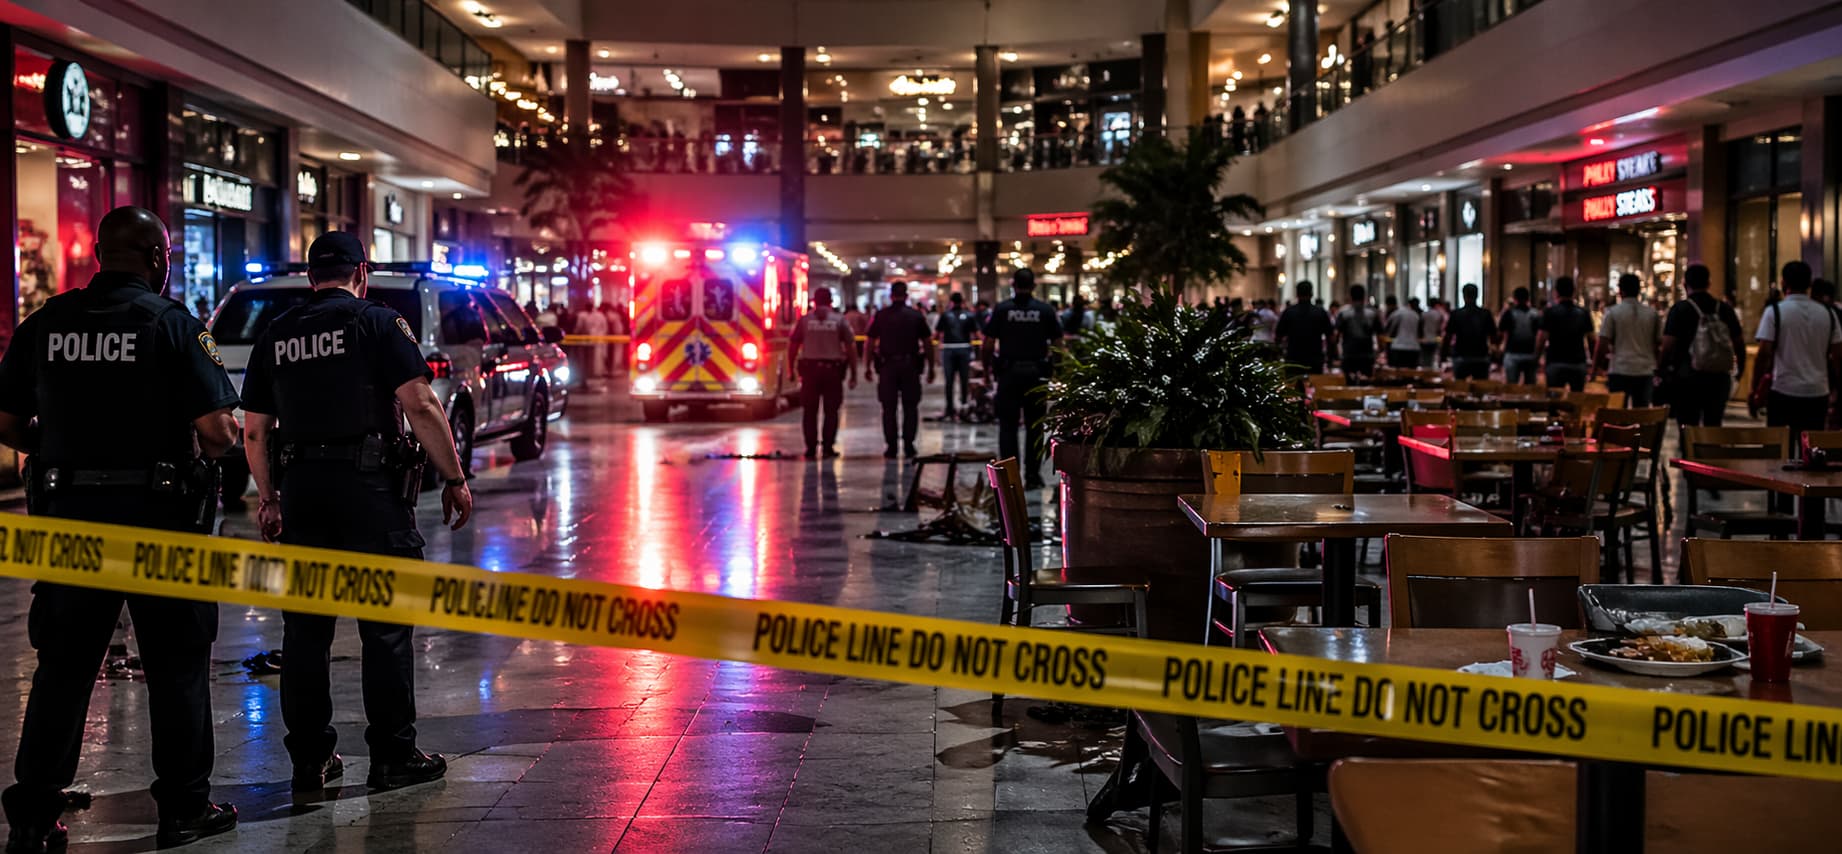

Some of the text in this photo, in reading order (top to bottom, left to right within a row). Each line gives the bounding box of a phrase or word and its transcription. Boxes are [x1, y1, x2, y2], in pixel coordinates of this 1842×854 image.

[1007, 310, 1040, 322] POLICE
[48, 332, 137, 362] POLICE
[274, 329, 345, 366] POLICE
[49, 531, 104, 572] CROSS
[133, 541, 194, 583] POLICE
[197, 548, 240, 588] LINE
[332, 563, 396, 607] CROSS
[530, 587, 560, 626] DO
[561, 591, 607, 633] NOT
[606, 597, 679, 640] CROSS
[752, 611, 1109, 690] POLICE LINE DO NOT CROSS
[1162, 656, 1587, 741] POLICE LINE DO NOT CROSS
[1651, 705, 1842, 766] POLICE LIN
